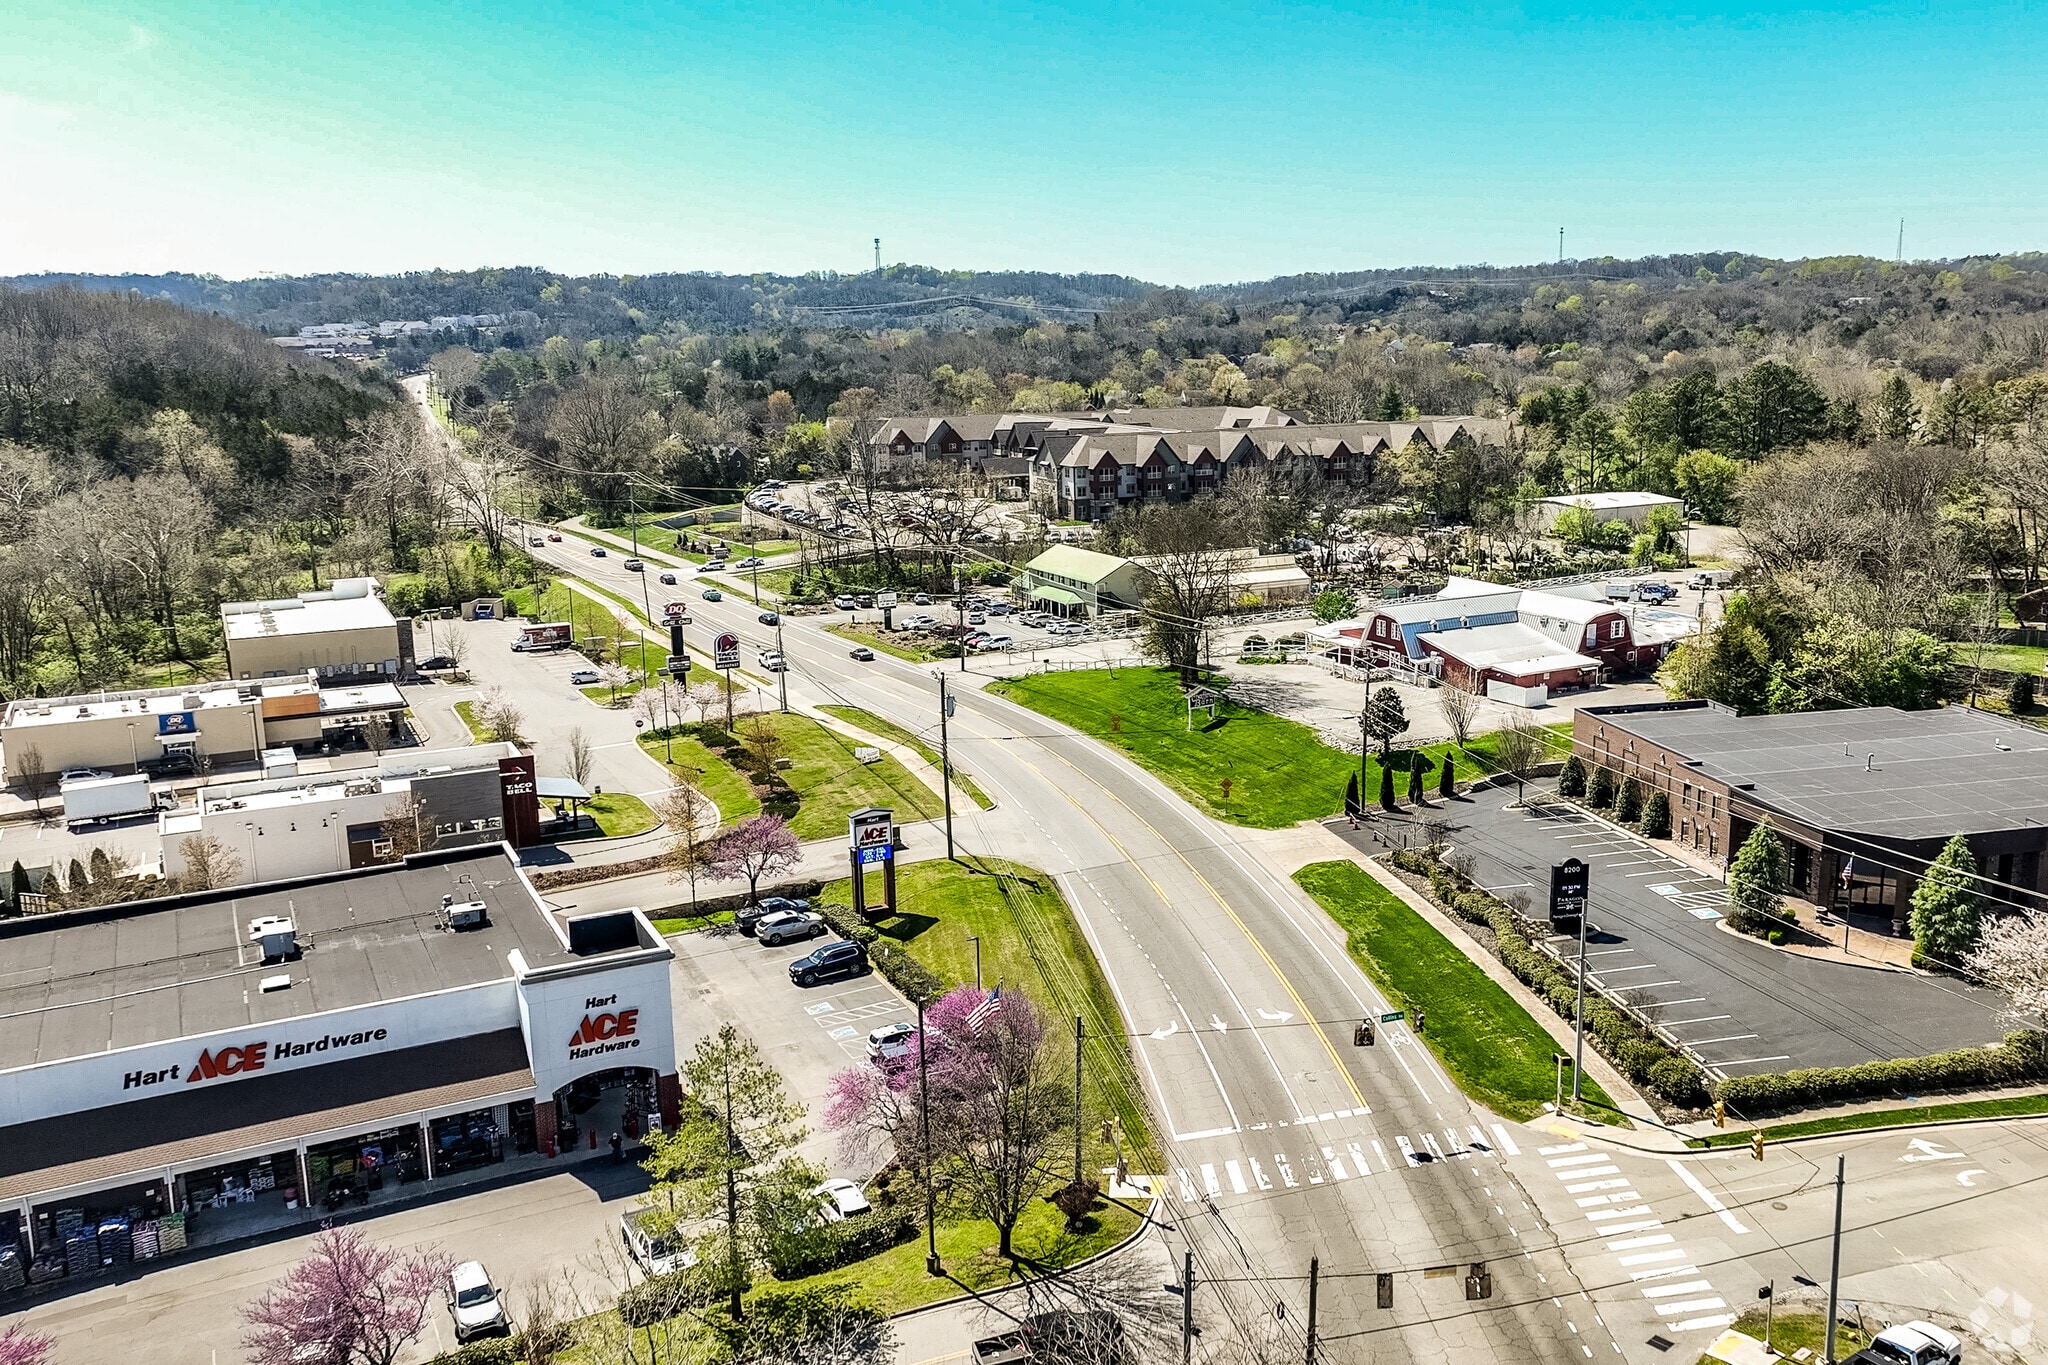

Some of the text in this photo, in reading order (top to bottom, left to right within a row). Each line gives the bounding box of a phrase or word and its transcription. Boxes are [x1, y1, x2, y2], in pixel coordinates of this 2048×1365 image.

[669, 605, 684, 613] DQ
[506, 782, 533, 790] TACO
[860, 827, 888, 841] ACE
[585, 994, 617, 1009] Hart
[568, 1009, 639, 1047] ACE
[569, 1039, 640, 1060] Hardware
[123, 1027, 387, 1090] Hart ACE Hardware
